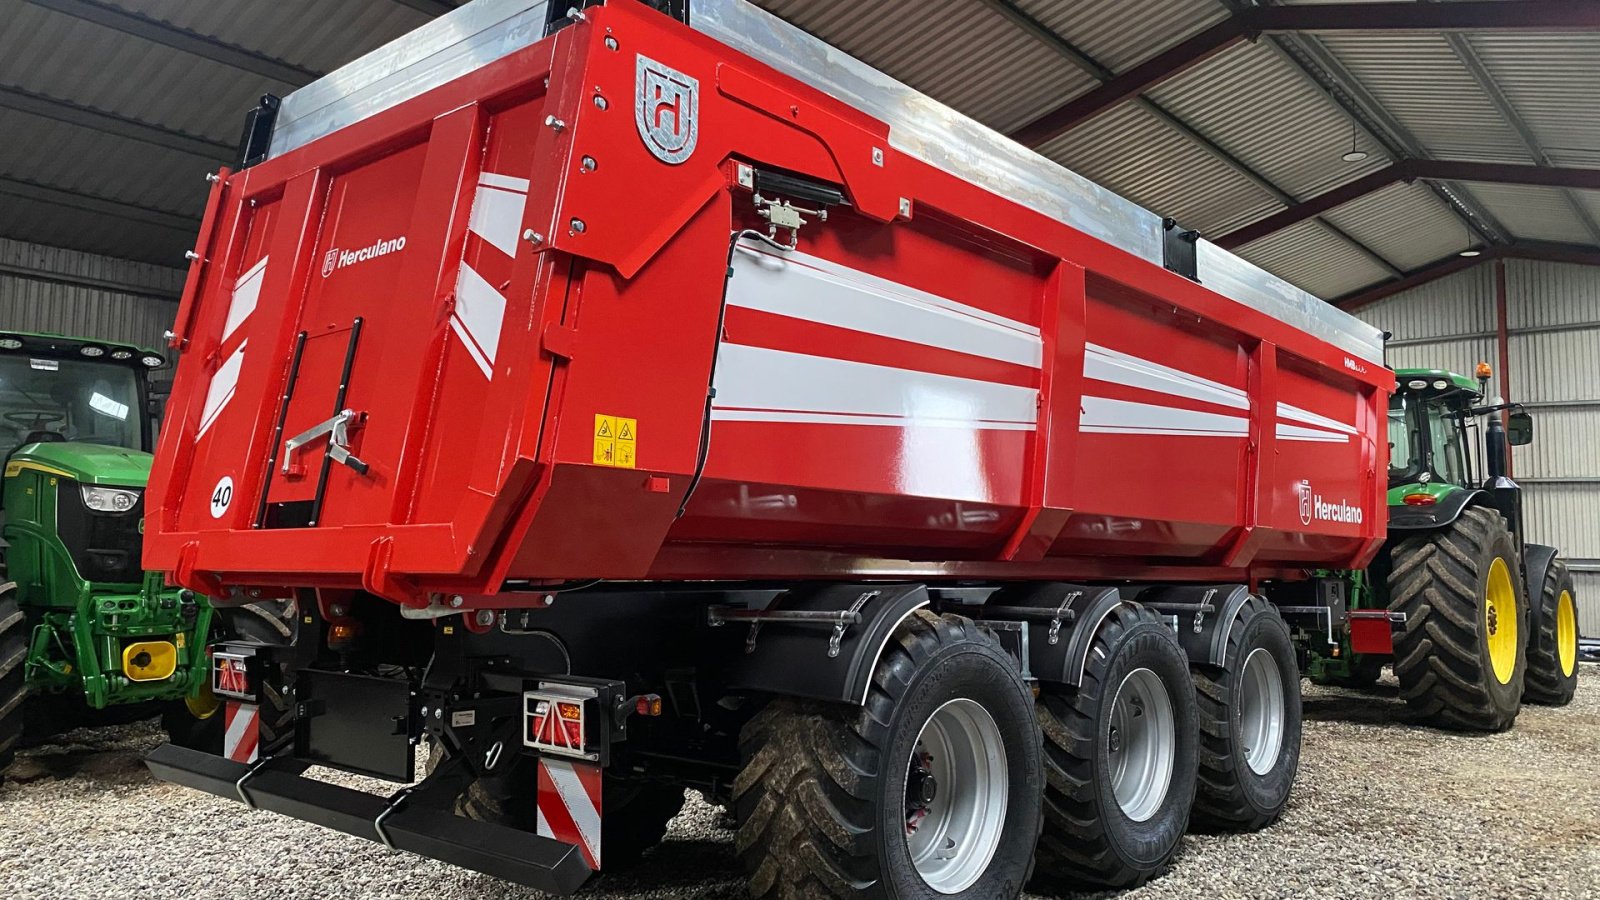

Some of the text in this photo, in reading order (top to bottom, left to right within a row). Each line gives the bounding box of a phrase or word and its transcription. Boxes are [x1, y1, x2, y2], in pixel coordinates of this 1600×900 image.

[337, 236, 406, 269] Herculano
[212, 486, 231, 507] 40
[1314, 494, 1362, 524] Herculano
